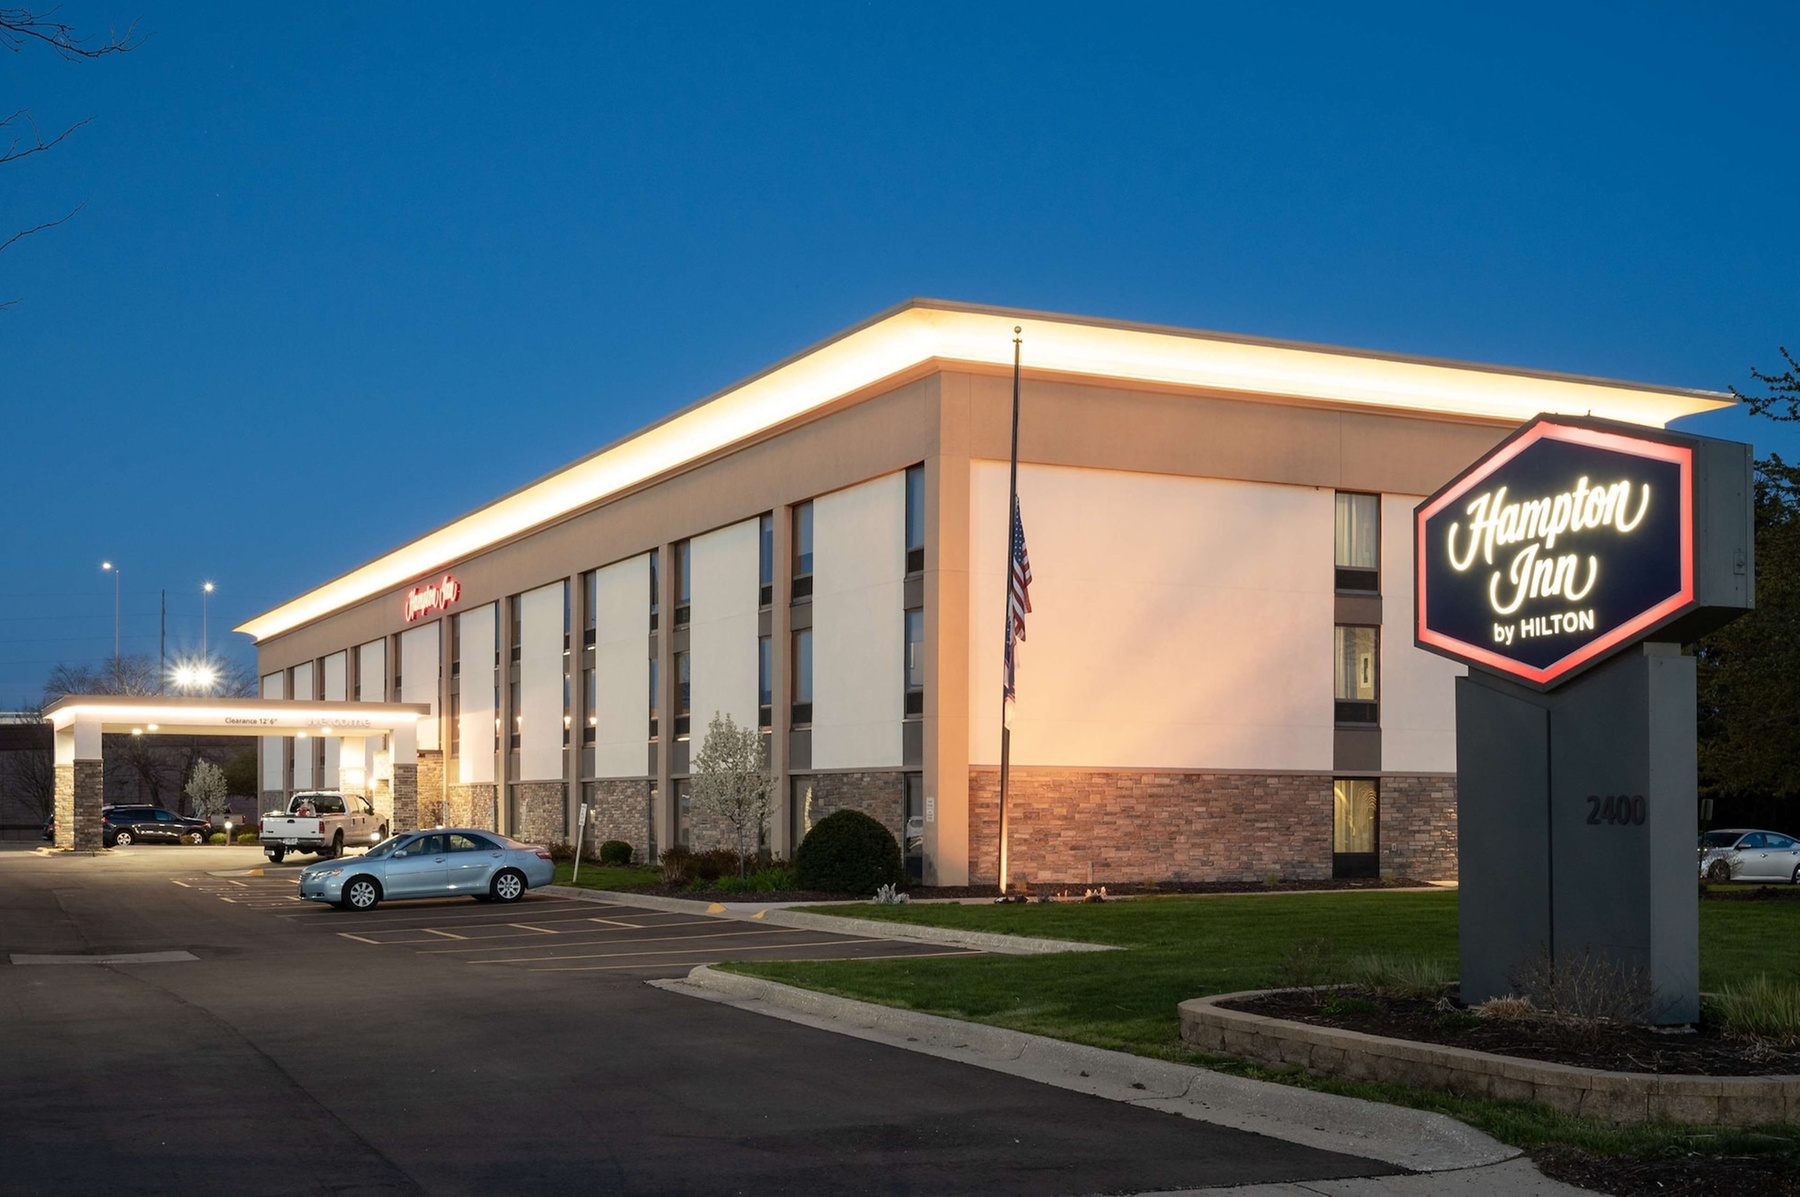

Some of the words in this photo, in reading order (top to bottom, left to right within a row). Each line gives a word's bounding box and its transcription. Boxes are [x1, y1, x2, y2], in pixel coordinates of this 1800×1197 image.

[1447, 475, 1650, 571] Hampton
[1489, 543, 1598, 615] Inn
[1493, 622, 1515, 646] by
[1520, 609, 1595, 639] HILTON
[225, 717, 258, 725] Clearance
[1586, 794, 1646, 826] 2400
